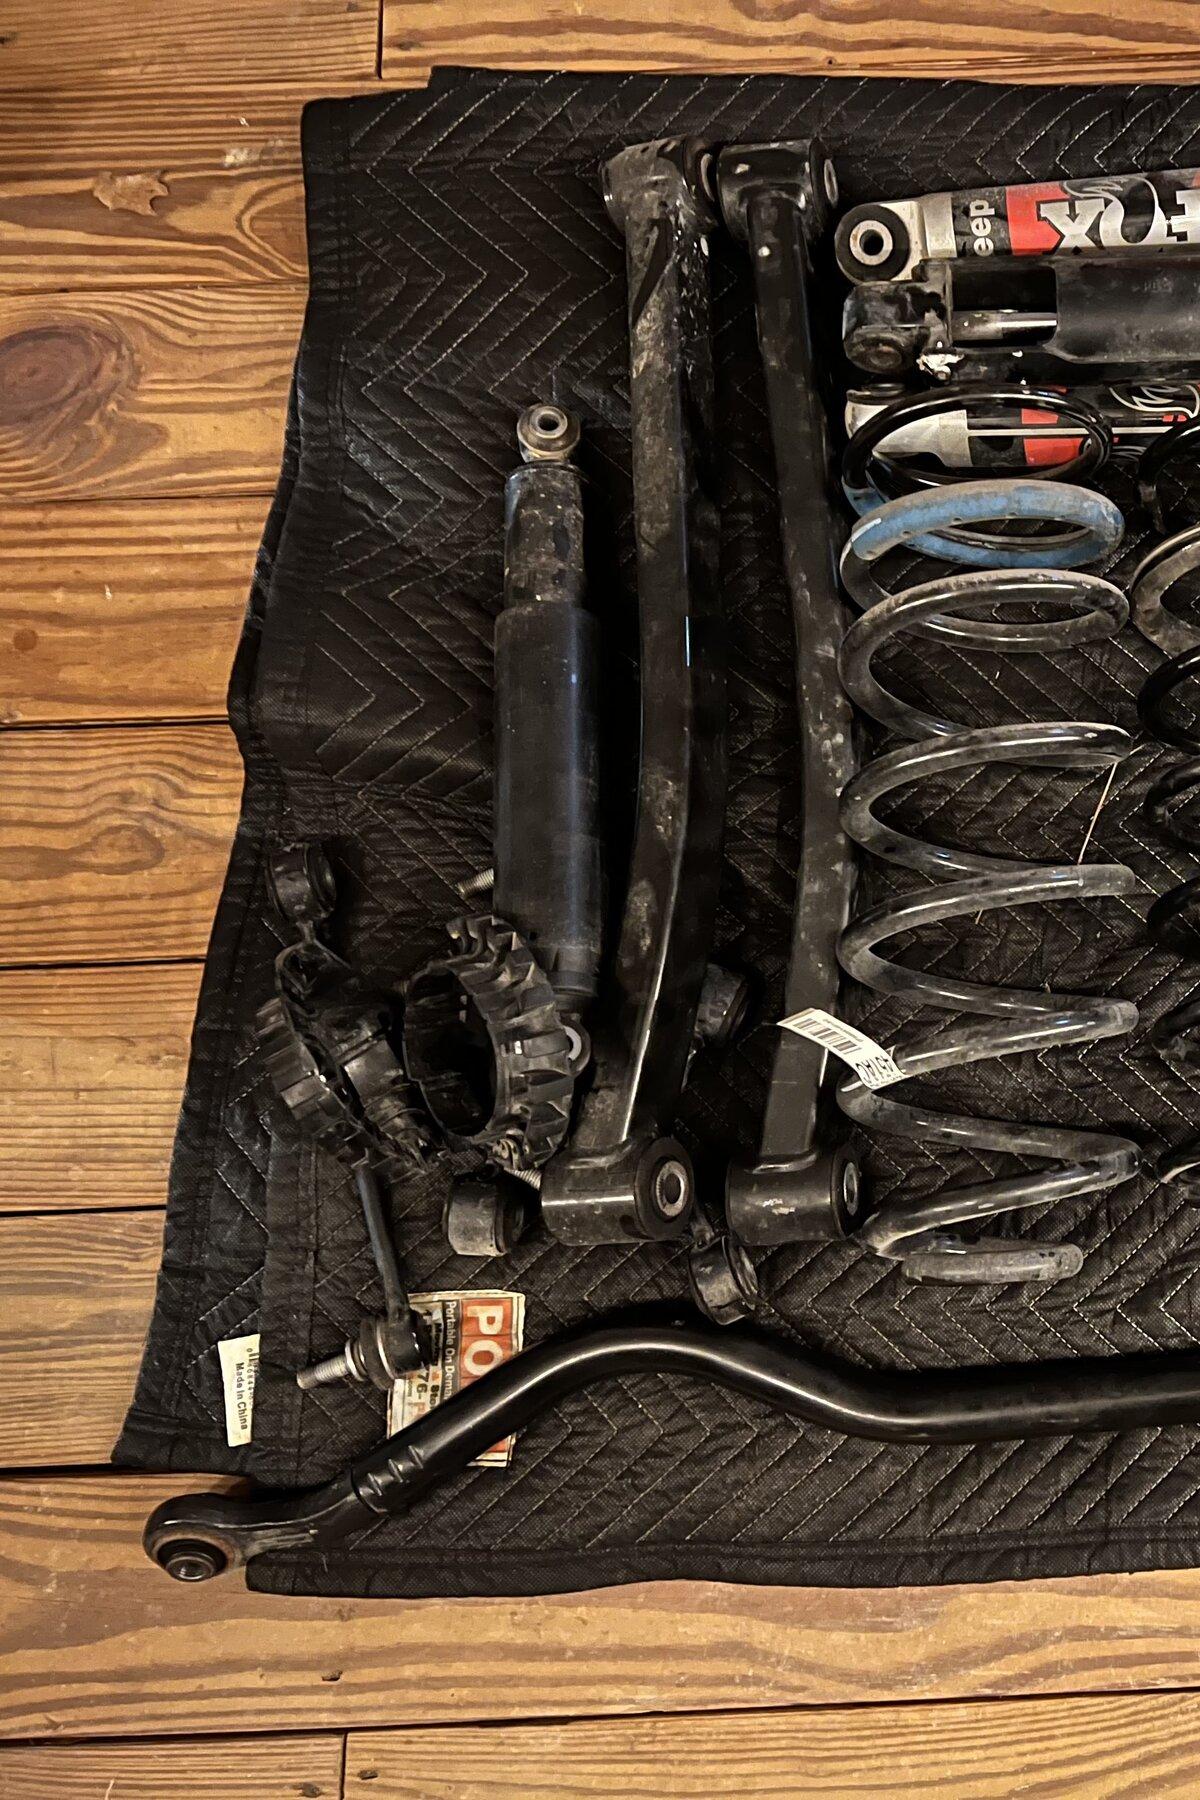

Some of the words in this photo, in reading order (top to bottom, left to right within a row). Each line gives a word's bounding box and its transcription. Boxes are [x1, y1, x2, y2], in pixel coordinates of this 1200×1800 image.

[969, 199, 995, 257] eep
[445, 1301, 458, 1345] Portable
[443, 1347, 456, 1364] On
[235, 1362, 245, 1388] Made
[237, 1401, 248, 1430] China
